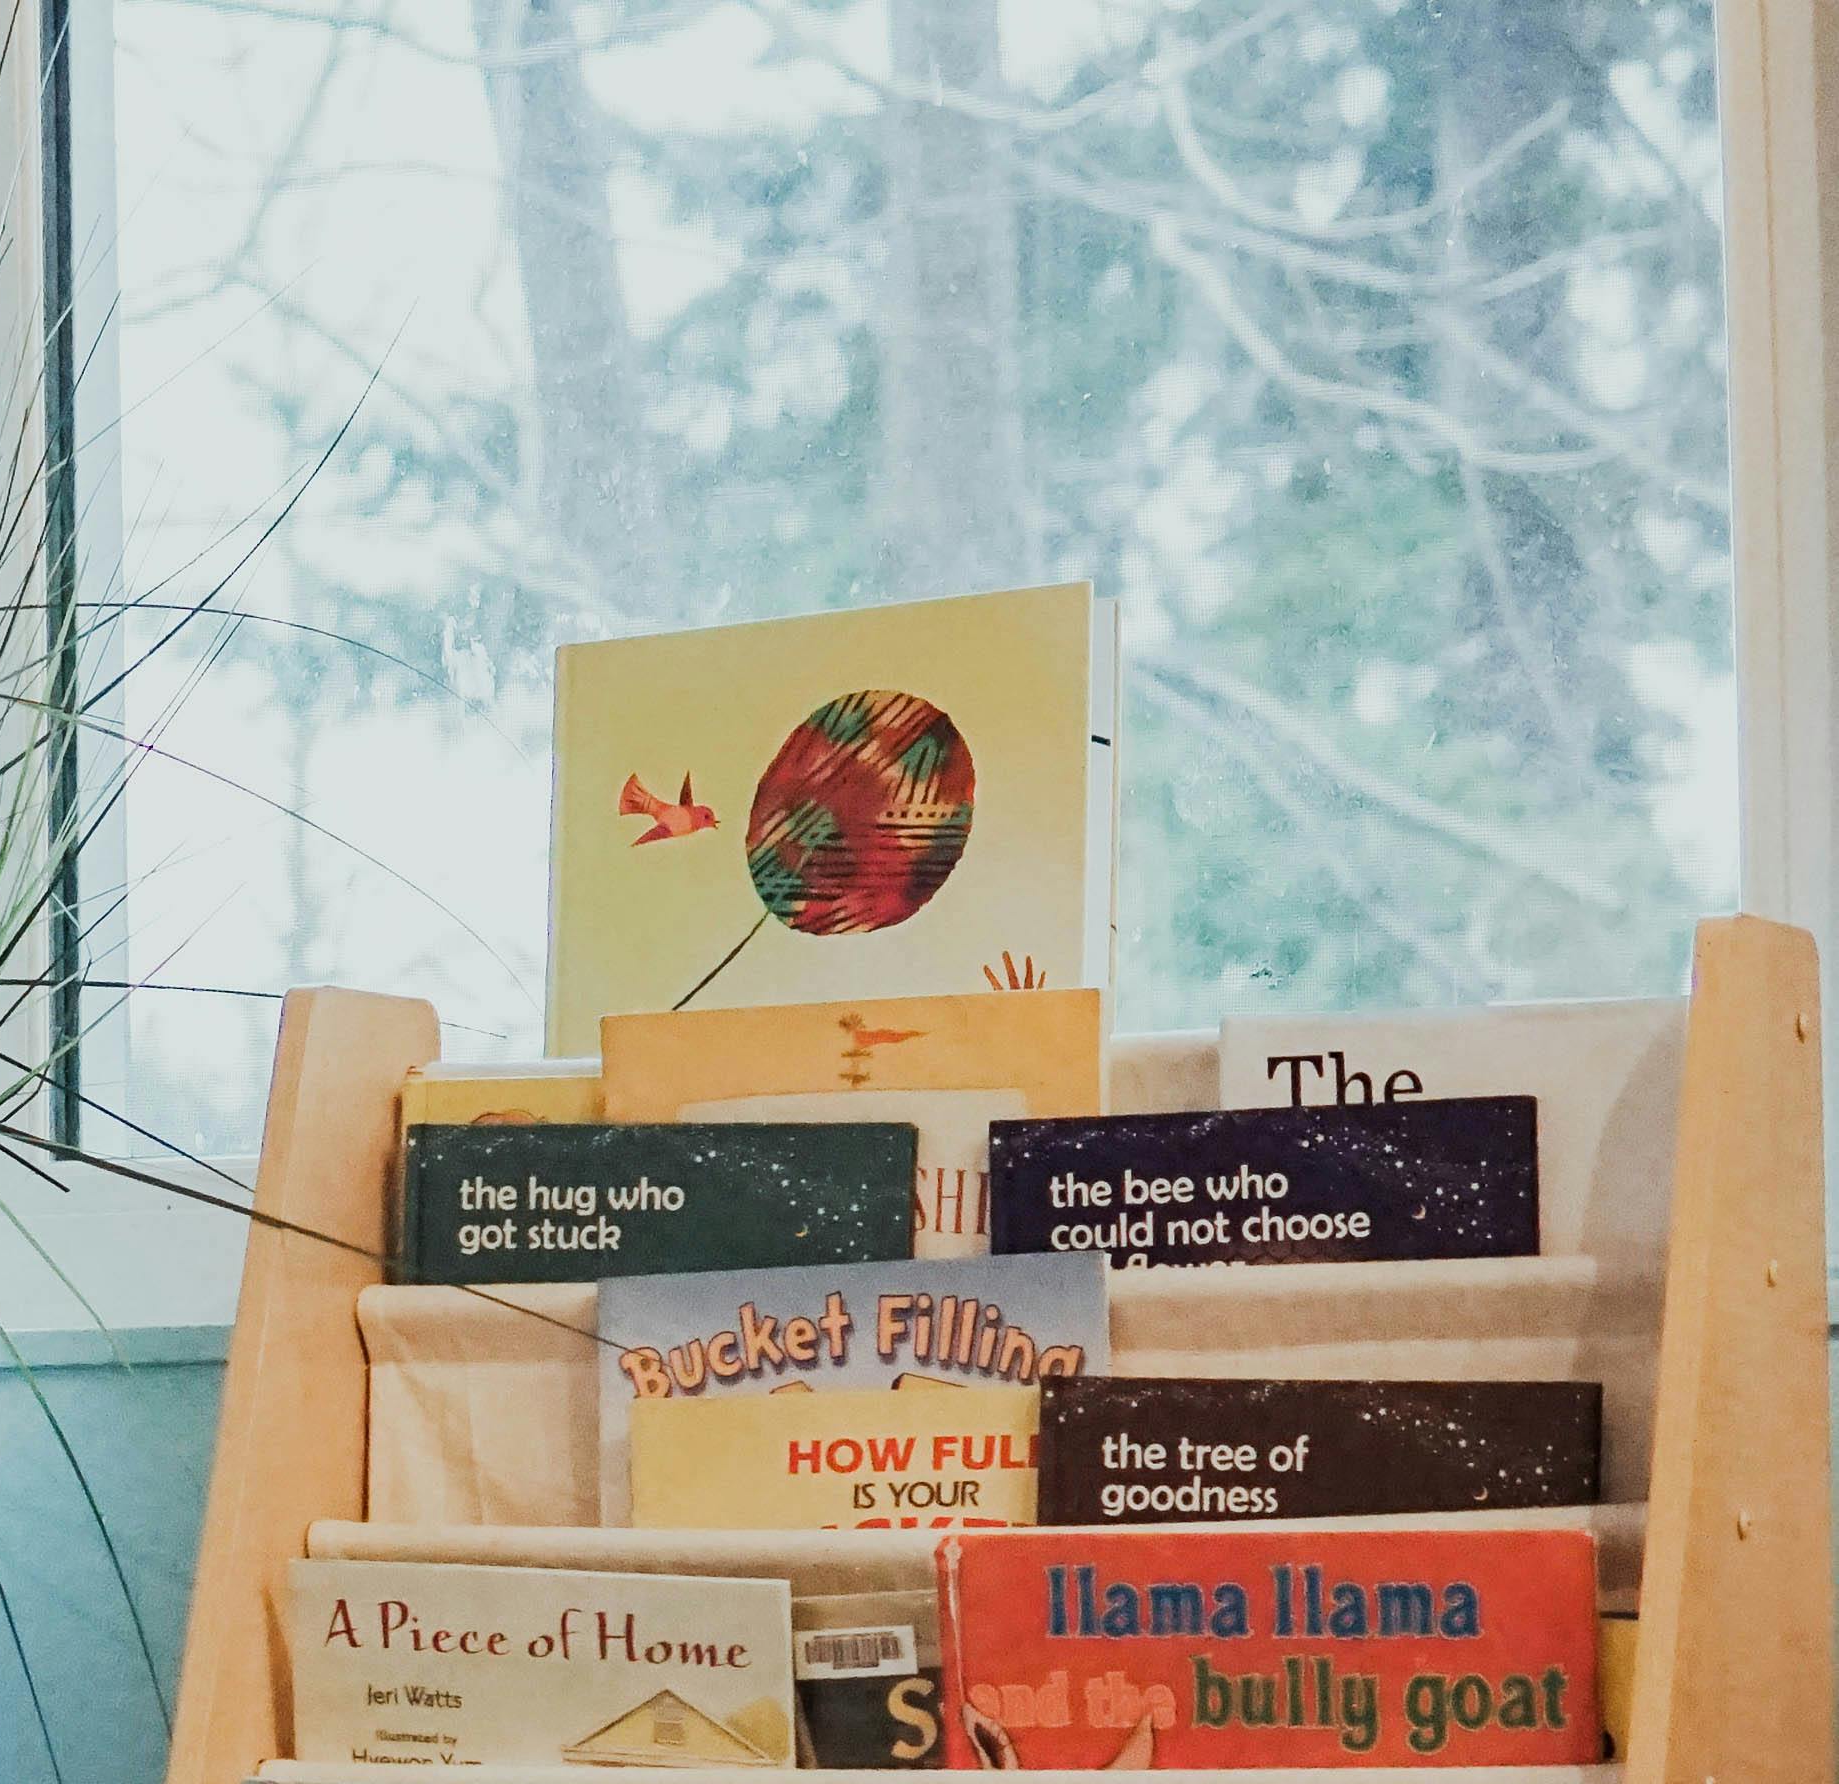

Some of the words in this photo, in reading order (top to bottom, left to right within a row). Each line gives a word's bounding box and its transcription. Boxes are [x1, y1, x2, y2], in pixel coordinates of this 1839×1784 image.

[1266, 1051, 1424, 1108] The
[459, 1176, 518, 1211] the
[528, 1176, 597, 1216] hug
[607, 1176, 686, 1211] who
[1050, 1172, 1112, 1208] the
[1124, 1169, 1195, 1205] bee
[1206, 1164, 1289, 1201] who
[458, 1218, 518, 1255] got
[528, 1215, 622, 1250] stuck
[1050, 1211, 1155, 1251] could
[1166, 1211, 1230, 1246] not
[1241, 1205, 1372, 1243] choose
[620, 1290, 852, 1399] Bucket
[787, 1437, 917, 1475] HOW
[1101, 1434, 1168, 1472] the
[1179, 1435, 1260, 1472] tree
[1268, 1434, 1310, 1472] of
[853, 1482, 877, 1510] IS
[886, 1480, 981, 1508] YOUR
[1101, 1476, 1280, 1517] goodness
[1045, 1564, 1254, 1640] llama
[1270, 1563, 1486, 1640] llama
[324, 1599, 363, 1649] A
[377, 1600, 512, 1656] Piece
[527, 1608, 583, 1660] of
[593, 1611, 753, 1669] Home
[404, 1685, 463, 1709] Watts
[969, 1670, 1073, 1728] and
[1084, 1671, 1177, 1729] the
[1188, 1653, 1380, 1754] bully
[1404, 1663, 1570, 1754] goat
